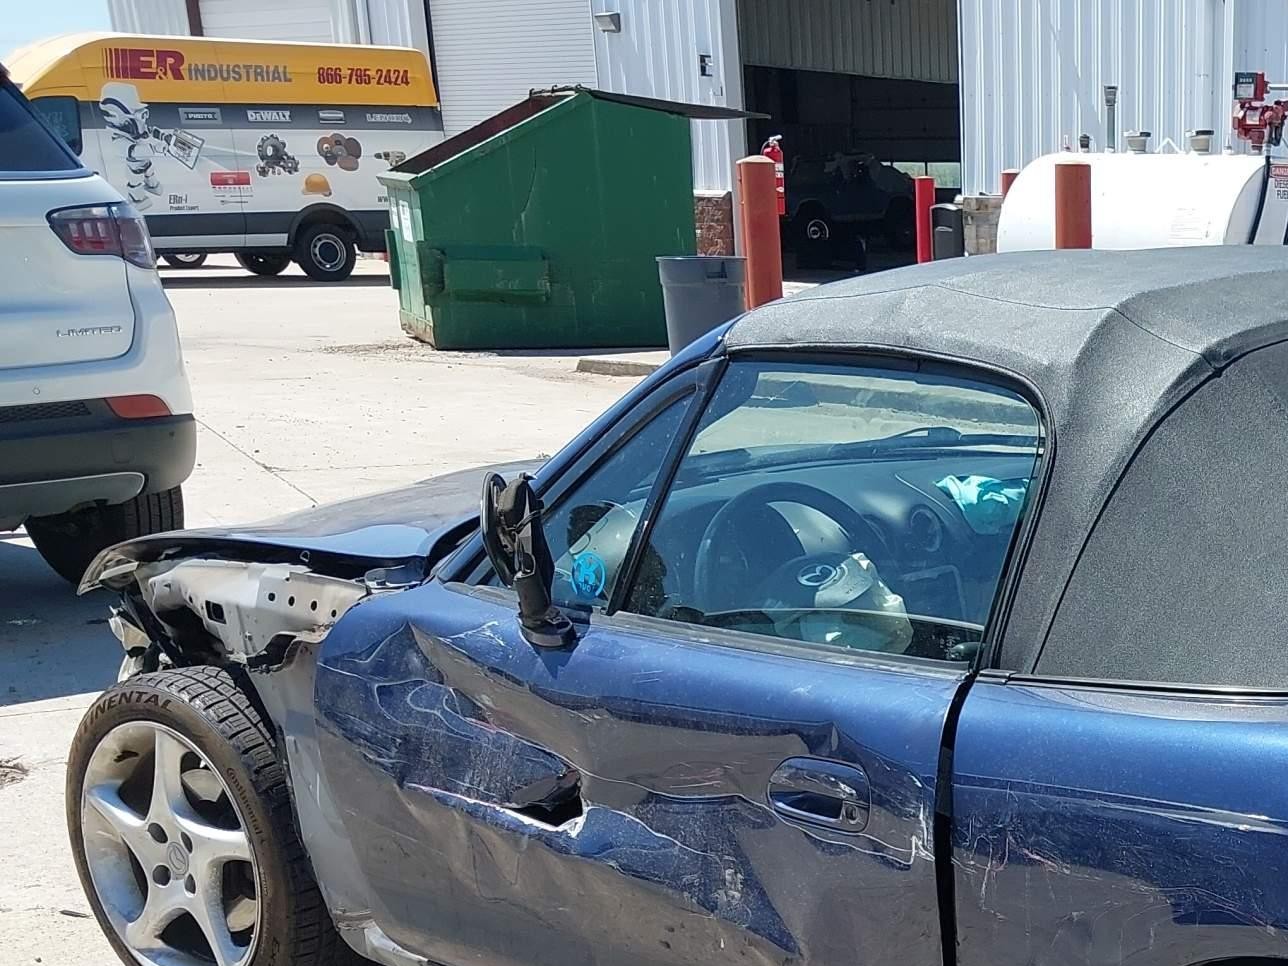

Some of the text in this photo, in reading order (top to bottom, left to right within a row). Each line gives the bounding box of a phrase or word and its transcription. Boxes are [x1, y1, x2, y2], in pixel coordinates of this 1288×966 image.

[188, 63, 292, 83] INDUSTRIAL
[317, 66, 410, 87] 866-795-2424
[56, 325, 122, 337] LIMITED
